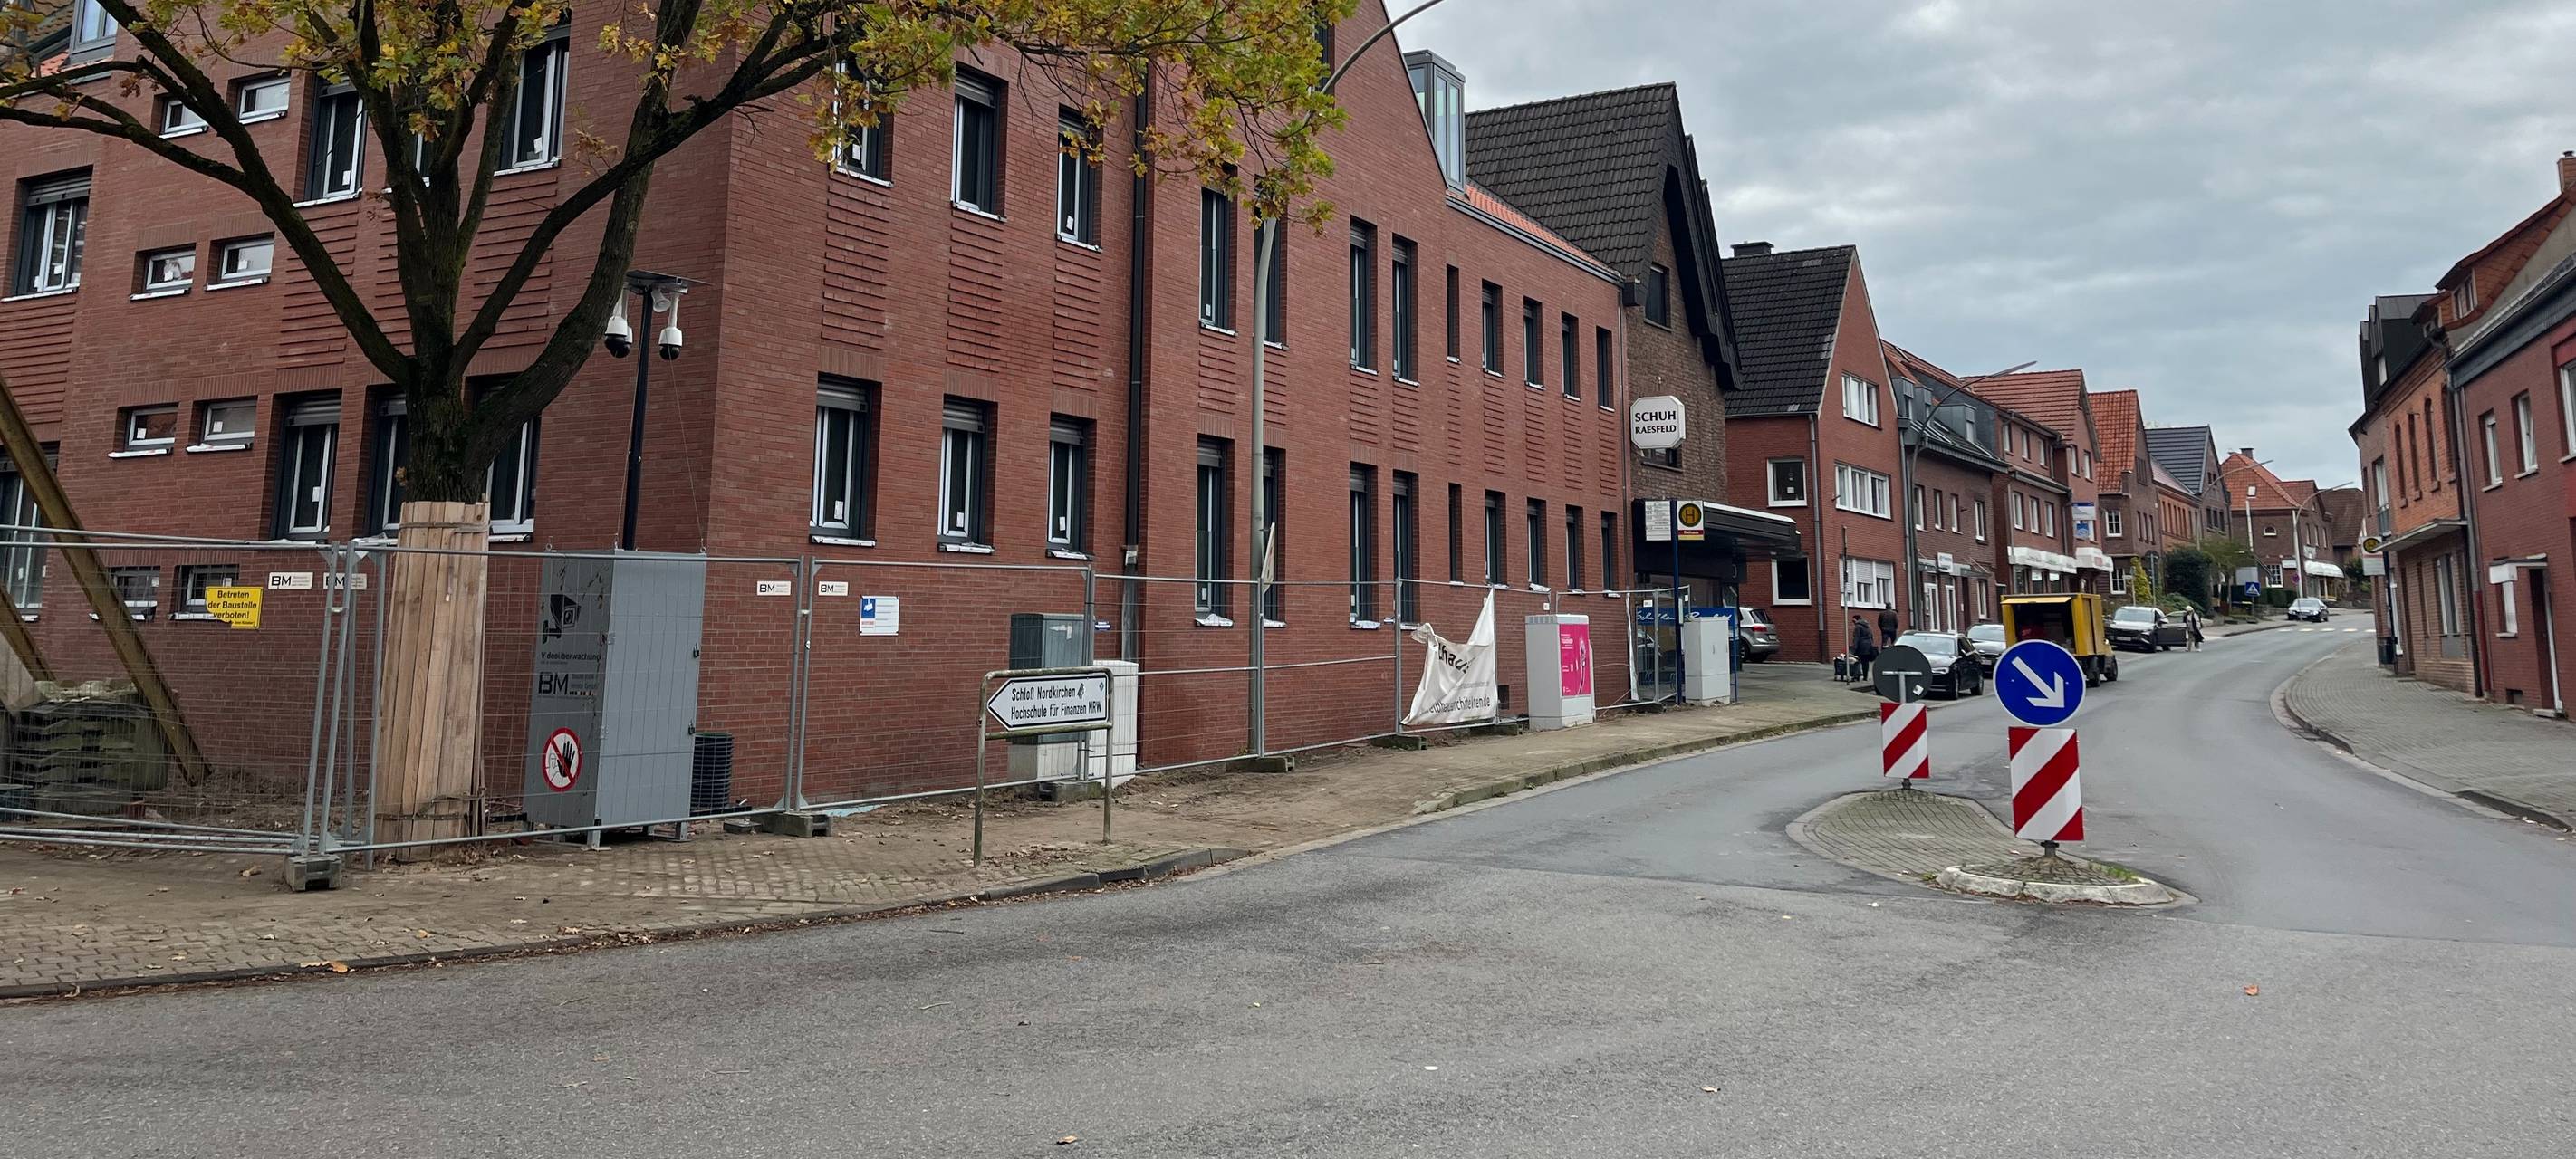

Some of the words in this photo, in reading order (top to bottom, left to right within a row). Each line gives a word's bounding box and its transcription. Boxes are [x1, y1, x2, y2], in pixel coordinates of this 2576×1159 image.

[1635, 410, 1677, 423] SCHUH
[1635, 425, 1677, 435] RAESFELD
[1685, 509, 1696, 522] H
[271, 575, 292, 586] BM
[759, 584, 775, 593] BM
[820, 584, 834, 593] BM
[217, 589, 250, 599] Betreten
[207, 600, 221, 609] der
[222, 600, 257, 609] Baustelle
[213, 610, 250, 619] verboten!
[538, 671, 569, 695] BM
[1011, 686, 1034, 702] Schloß
[1036, 685, 1076, 701] Nordkirchen
[1010, 704, 1047, 720] Hochschule
[1049, 703, 1059, 717] für
[1061, 702, 1087, 717] Finanzen
[1088, 701, 1102, 714] NRW
